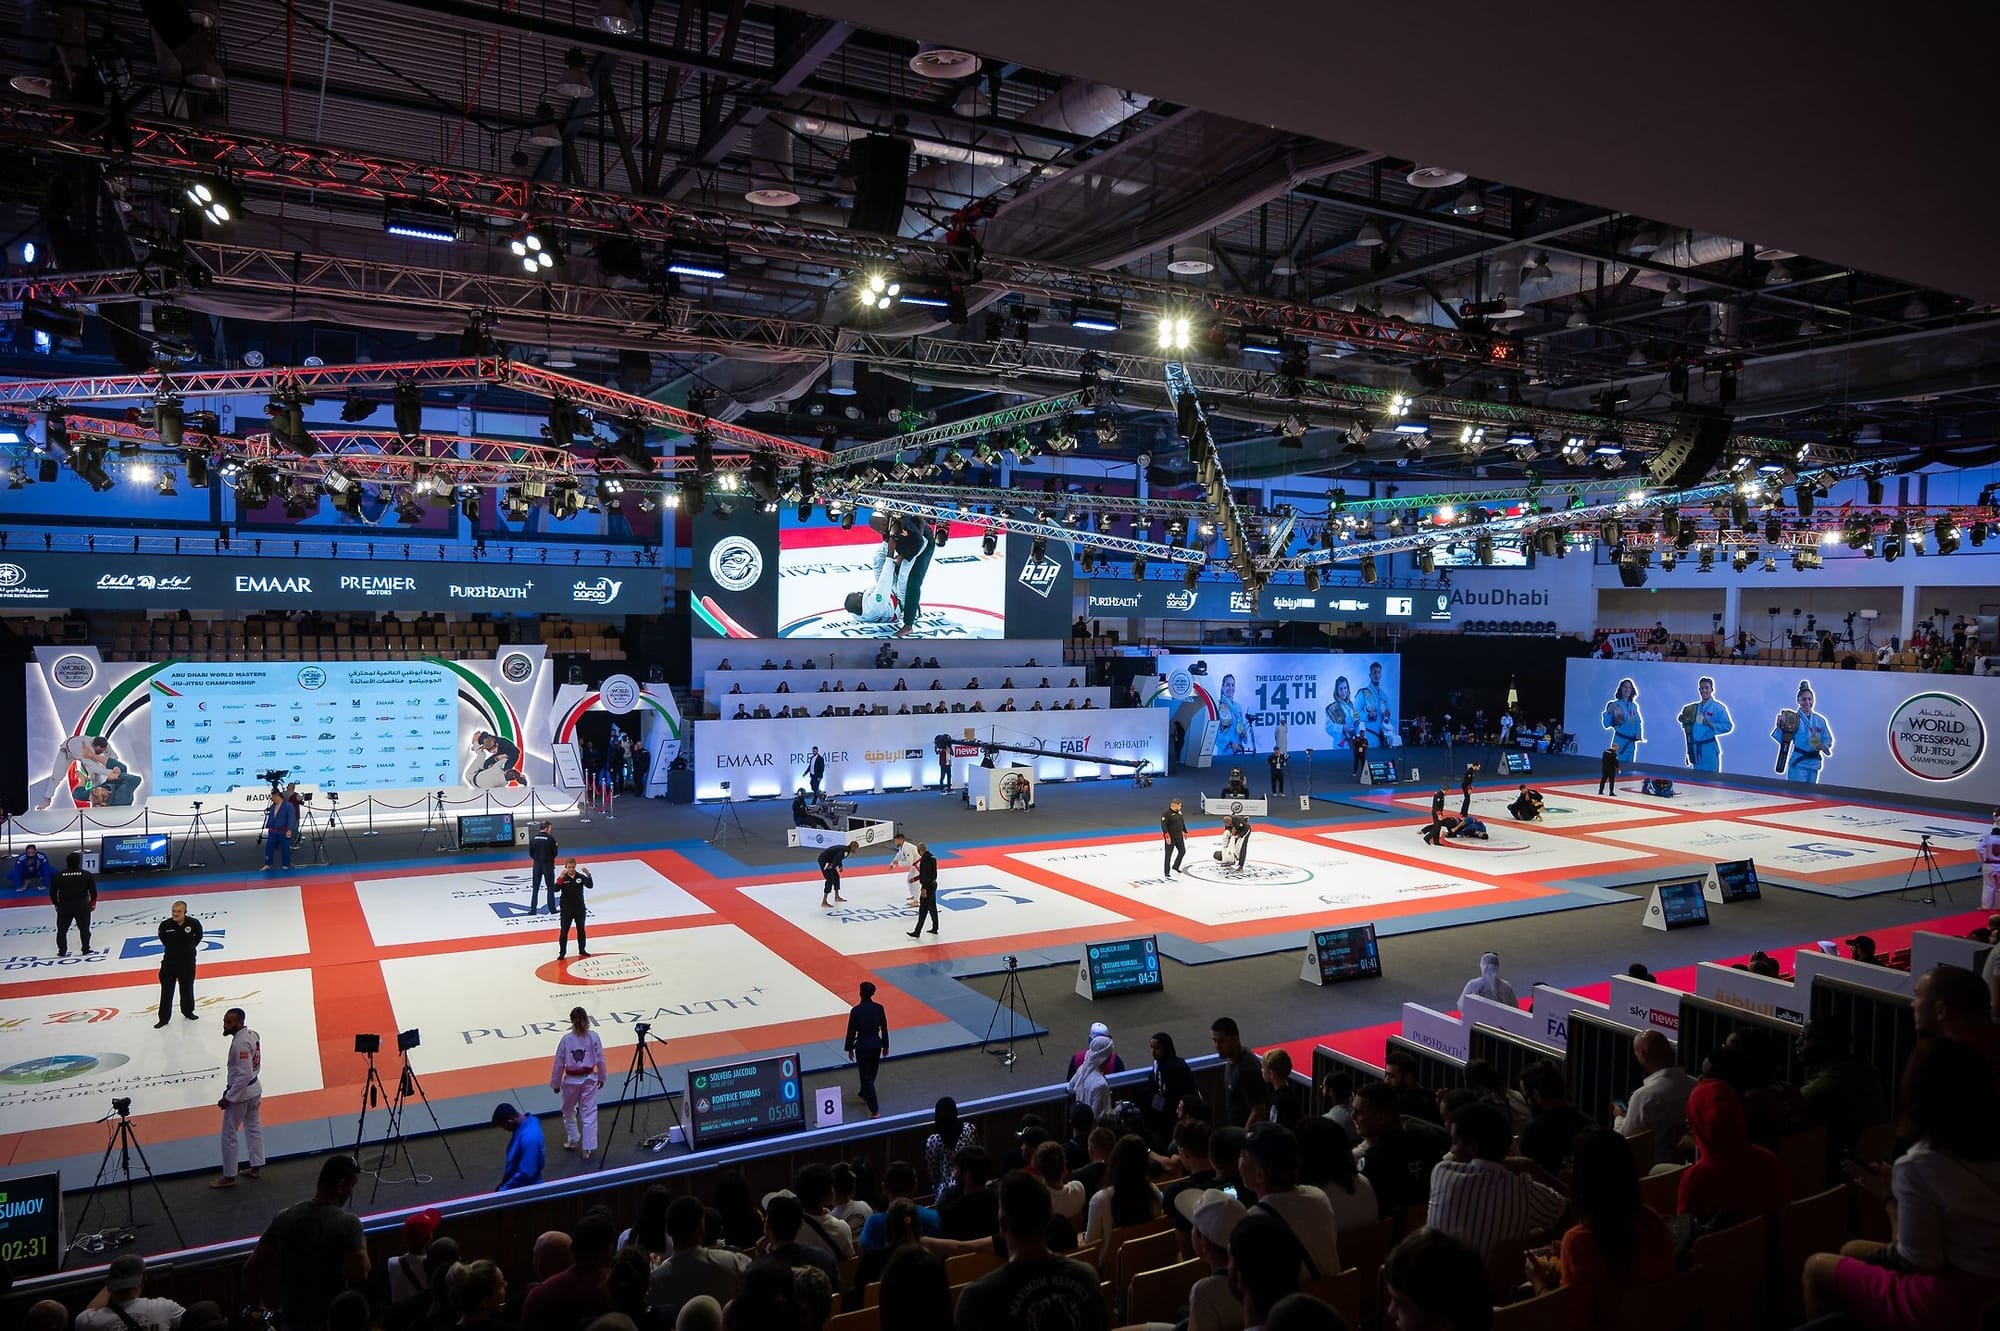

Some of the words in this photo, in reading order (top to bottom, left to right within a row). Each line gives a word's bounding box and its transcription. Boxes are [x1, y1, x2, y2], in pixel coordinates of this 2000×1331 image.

[235, 576, 312, 592] EMAAR
[340, 576, 416, 590] PREMIER
[1269, 674, 1294, 682] LEGACY
[1254, 711, 1317, 727] EDITION
[1908, 717, 1965, 734] WORLD
[1900, 732, 1971, 747] PROFESSIONAL
[864, 749, 905, 765] الرياضية
[956, 747, 978, 756] news
[1913, 745, 1956, 757] JIU-JITSU
[717, 752, 774, 769] EMAAR
[1910, 755, 1958, 766] CHAMPIONSHIP
[519, 832, 526, 840] 9
[115, 843, 133, 851] OSAMA
[85, 859, 96, 868] 11
[145, 856, 164, 865] 05:00
[1145, 940, 1153, 953] 0
[4, 955, 106, 970] DNOC
[1148, 956, 1156, 969] 0
[1360, 957, 1378, 970] 01:41
[1138, 971, 1158, 984] 04:57
[1630, 1005, 1648, 1020] sky
[1650, 1012, 1681, 1029] news
[1547, 1019, 1568, 1040] FA
[709, 1070, 732, 1082] SOLVEIG
[732, 1066, 757, 1079] JACCOUD
[782, 1060, 794, 1077] 0
[69, 1072, 221, 1098] DEVELOPMENT
[784, 1081, 796, 1099] 0
[739, 1088, 761, 1100] THOMAS
[768, 1102, 799, 1121] 05:00
[824, 1099, 835, 1115] 8
[0, 1198, 44, 1220] SUMOV
[2, 1236, 47, 1262] 02:31
